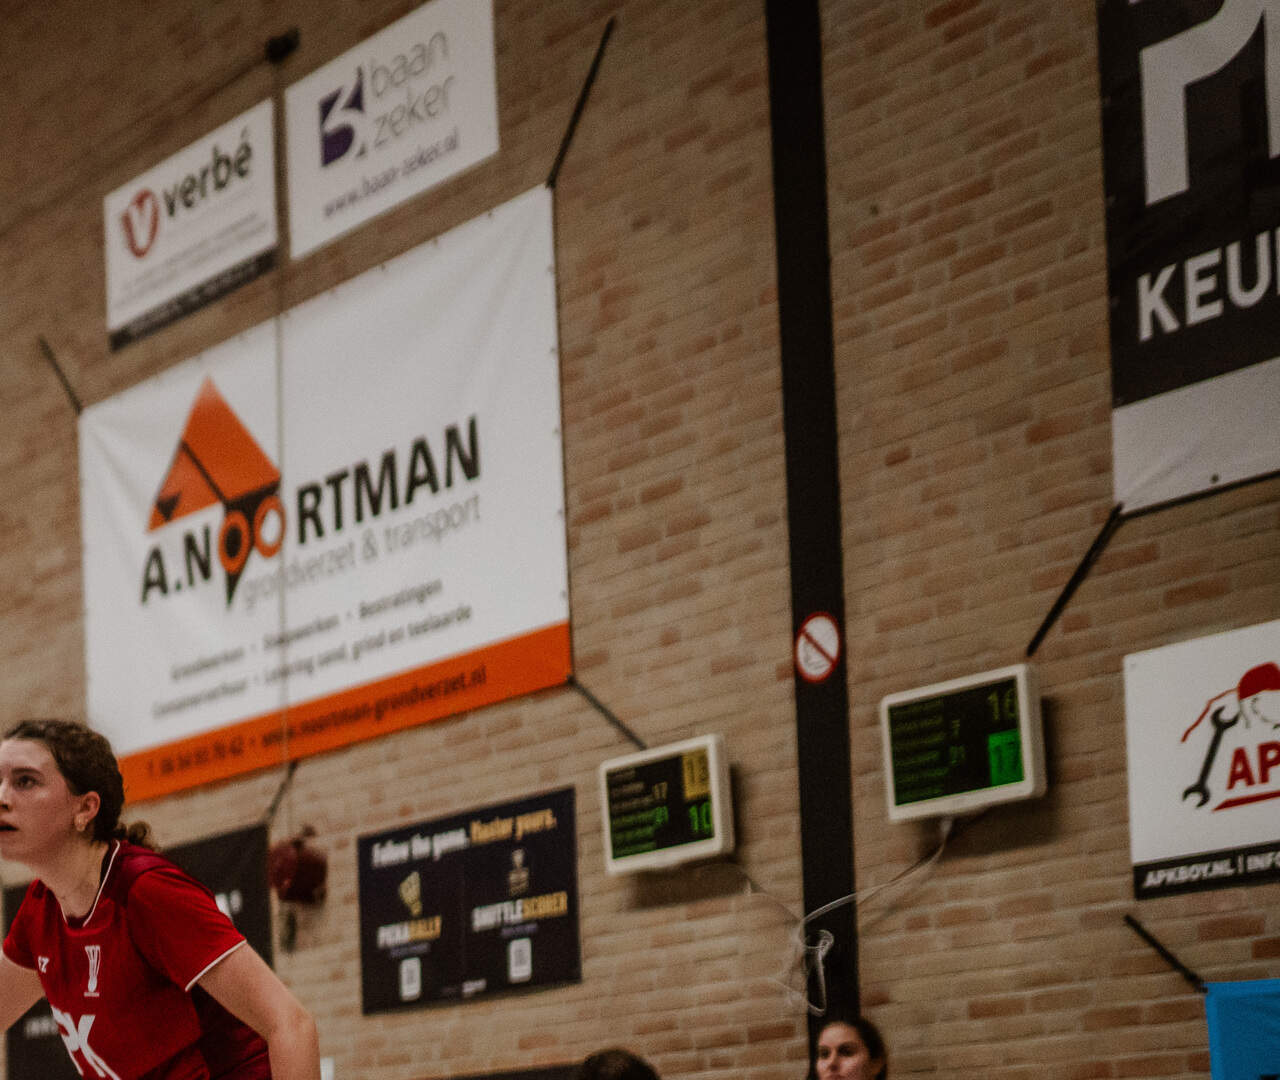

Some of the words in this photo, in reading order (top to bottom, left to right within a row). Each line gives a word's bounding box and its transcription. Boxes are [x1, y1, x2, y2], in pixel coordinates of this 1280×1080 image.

[370, 31, 450, 98] baan
[374, 75, 455, 148] zeker
[163, 124, 253, 217] verbé
[1137, 226, 1280, 341] KEU
[241, 540, 356, 612] grondverzet
[385, 494, 481, 553] transport
[410, 833, 431, 861] the
[1142, 857, 1238, 889] APKBOY.NL
